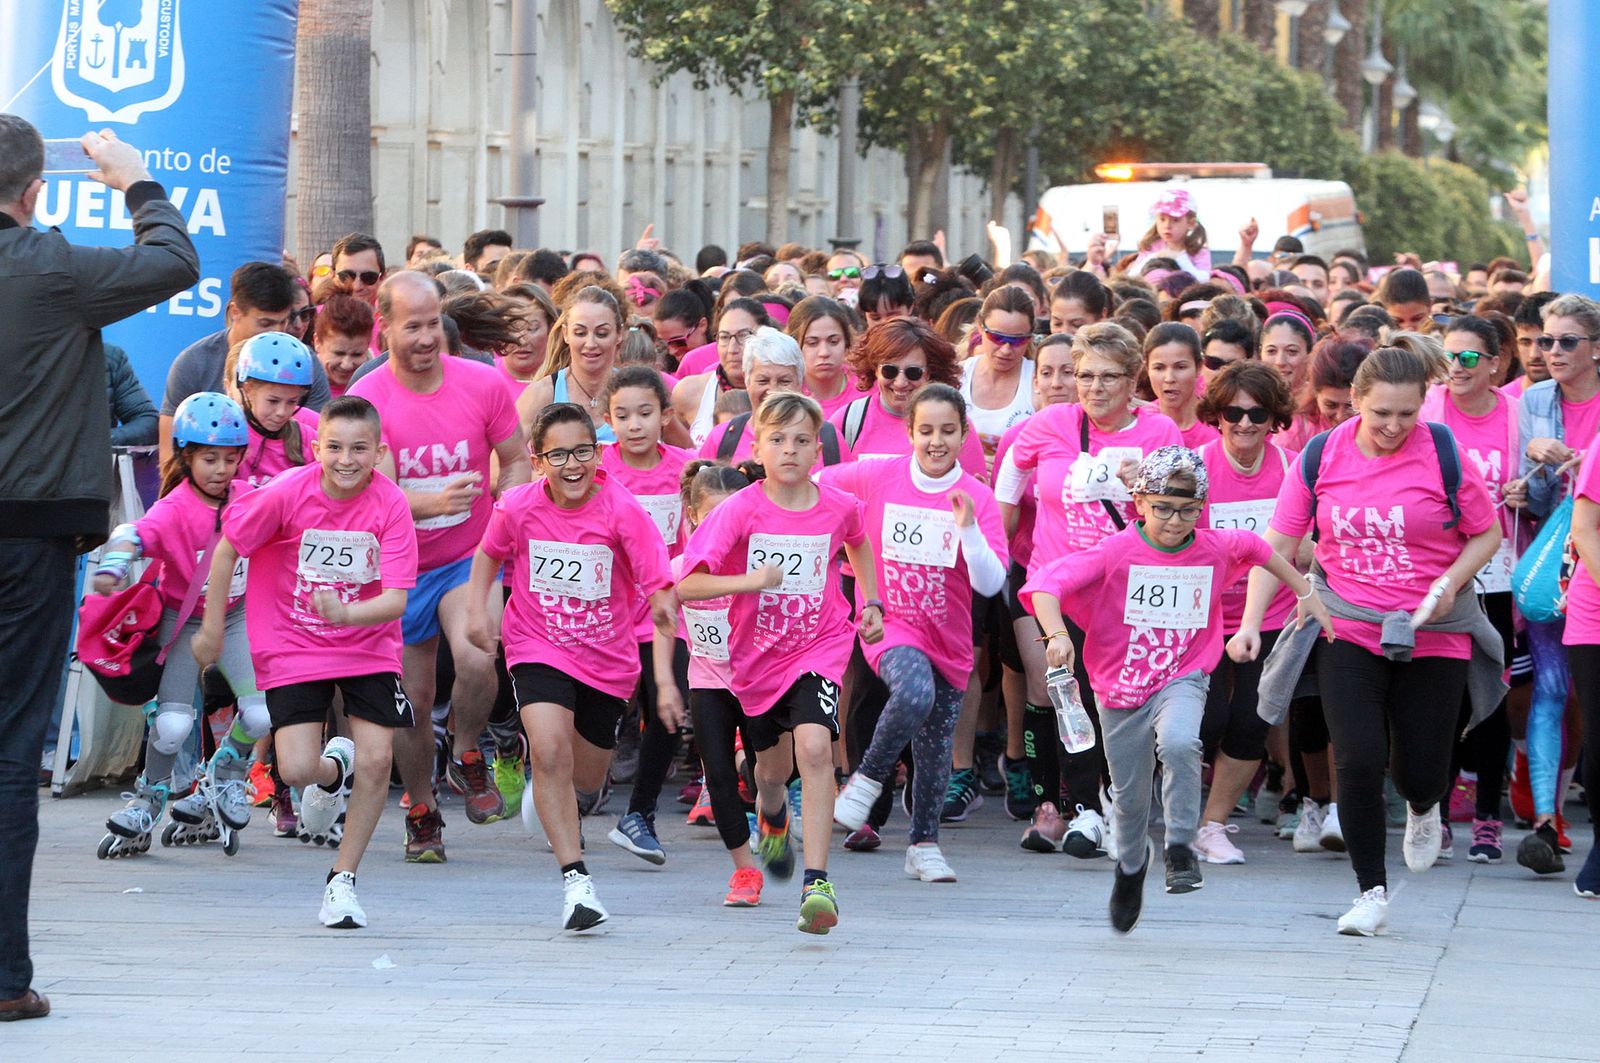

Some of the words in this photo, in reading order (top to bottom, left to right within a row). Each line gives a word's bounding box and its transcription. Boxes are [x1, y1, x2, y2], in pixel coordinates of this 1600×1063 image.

[66, 21, 79, 69] PORTUS
[199, 147, 231, 174] de
[399, 439, 469, 476] KM
[892, 521, 923, 545] 86
[1331, 505, 1405, 538] KM
[304, 543, 353, 567] 725
[1336, 537, 1409, 558] POR
[534, 555, 582, 582] 722
[751, 549, 803, 576] 322
[1342, 554, 1413, 575] ELLAS
[883, 564, 946, 593] POR
[757, 592, 824, 618] POR
[886, 589, 946, 609] ELLAS
[1130, 584, 1178, 608] 481
[694, 623, 722, 645] 38
